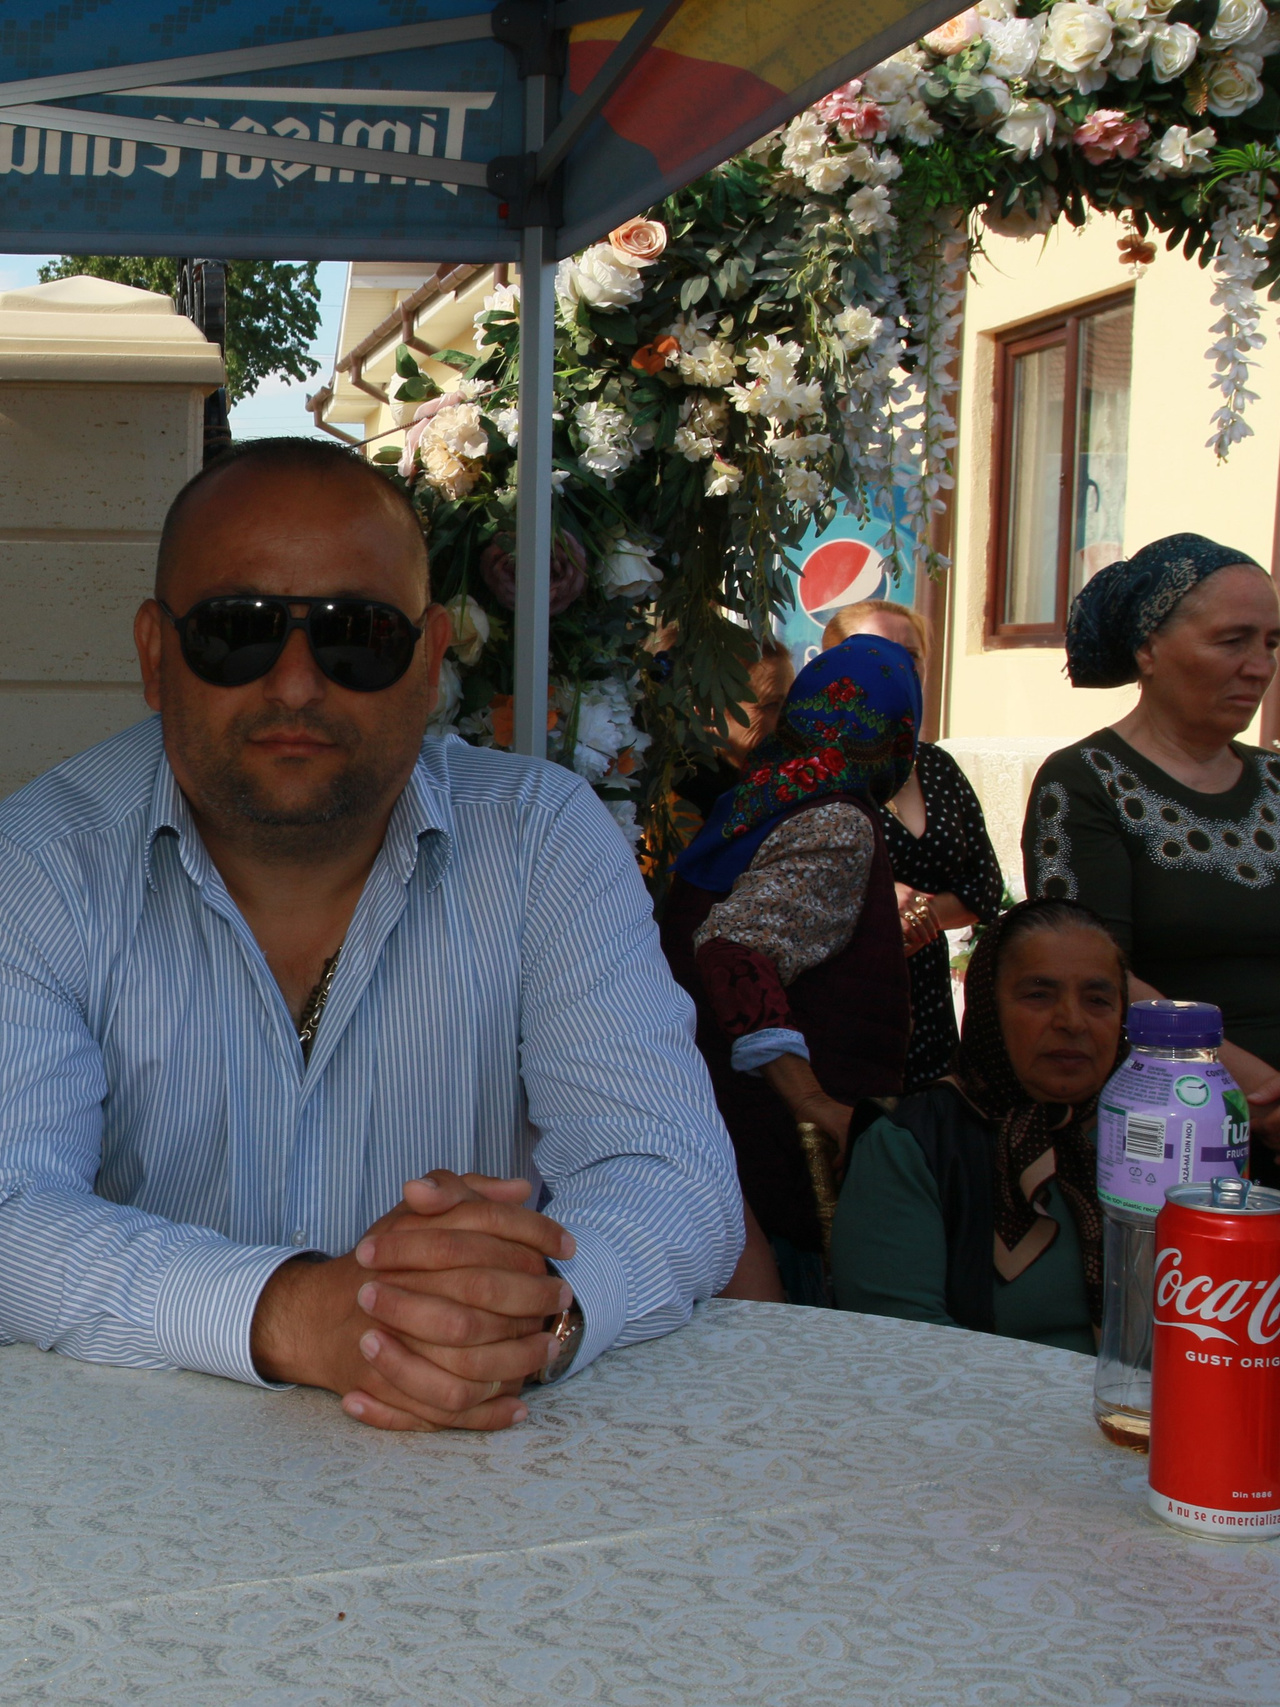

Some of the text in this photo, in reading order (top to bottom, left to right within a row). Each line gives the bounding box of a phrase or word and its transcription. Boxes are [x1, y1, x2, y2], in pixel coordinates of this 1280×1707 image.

[1185, 1123, 1193, 1139] NOU
[1185, 1351, 1233, 1367] GUST
[1167, 1501, 1173, 1513] A
[1177, 1506, 1189, 1518] nu
[1194, 1511, 1206, 1522] se
